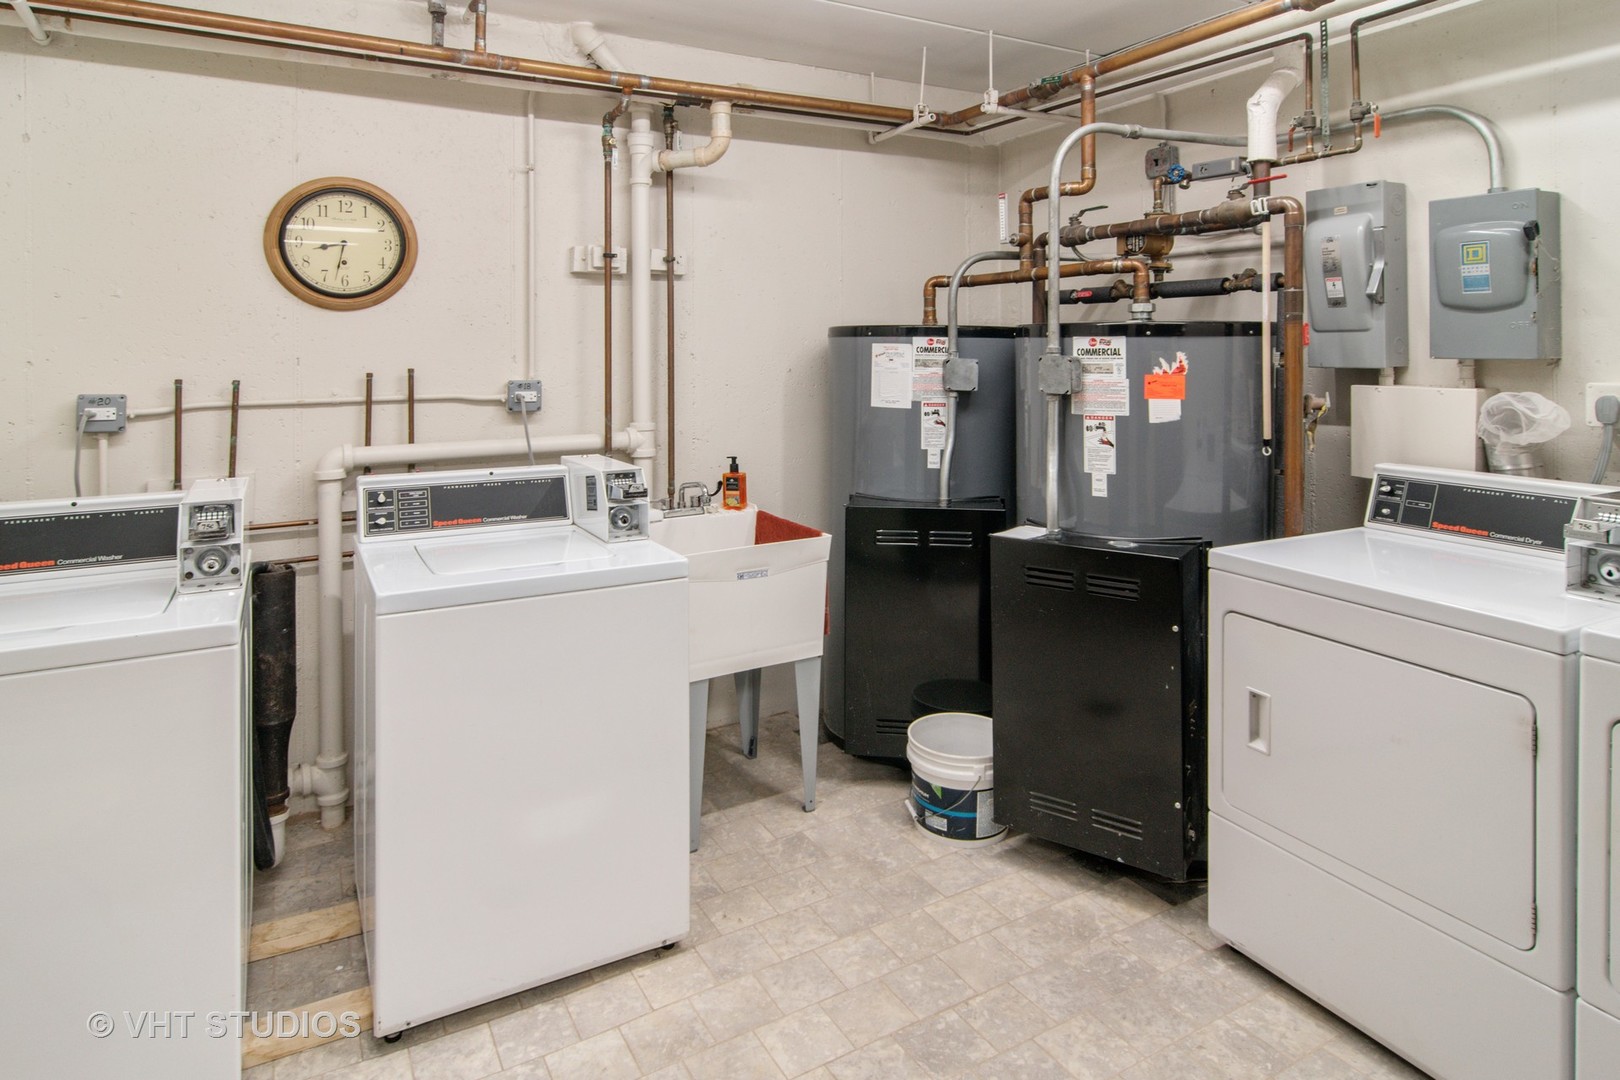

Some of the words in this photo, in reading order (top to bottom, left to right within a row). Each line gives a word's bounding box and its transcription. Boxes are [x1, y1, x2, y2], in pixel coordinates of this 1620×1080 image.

[317, 205, 328, 218] 11
[338, 200, 353, 214] 12
[362, 206, 368, 218] 1
[301, 217, 315, 230] 10
[377, 220, 385, 233] 2
[295, 236, 303, 248] 9
[384, 239, 392, 251] 3
[301, 256, 310, 268] 8
[378, 257, 386, 269] 4
[320, 269, 328, 282] 7
[341, 274, 349, 287] 6
[363, 271, 371, 283] 5
[1077, 348, 1121, 356] COMMERCIAL
[1432, 522, 1459, 532] Speed
[1460, 526, 1489, 537] Queen
[1489, 531, 1524, 543] Commercial
[1525, 537, 1543, 546] Dryer
[0, 562, 18, 571] eed
[19, 560, 55, 569] Queen
[57, 556, 97, 566] Commercial
[97, 554, 124, 562] Washer
